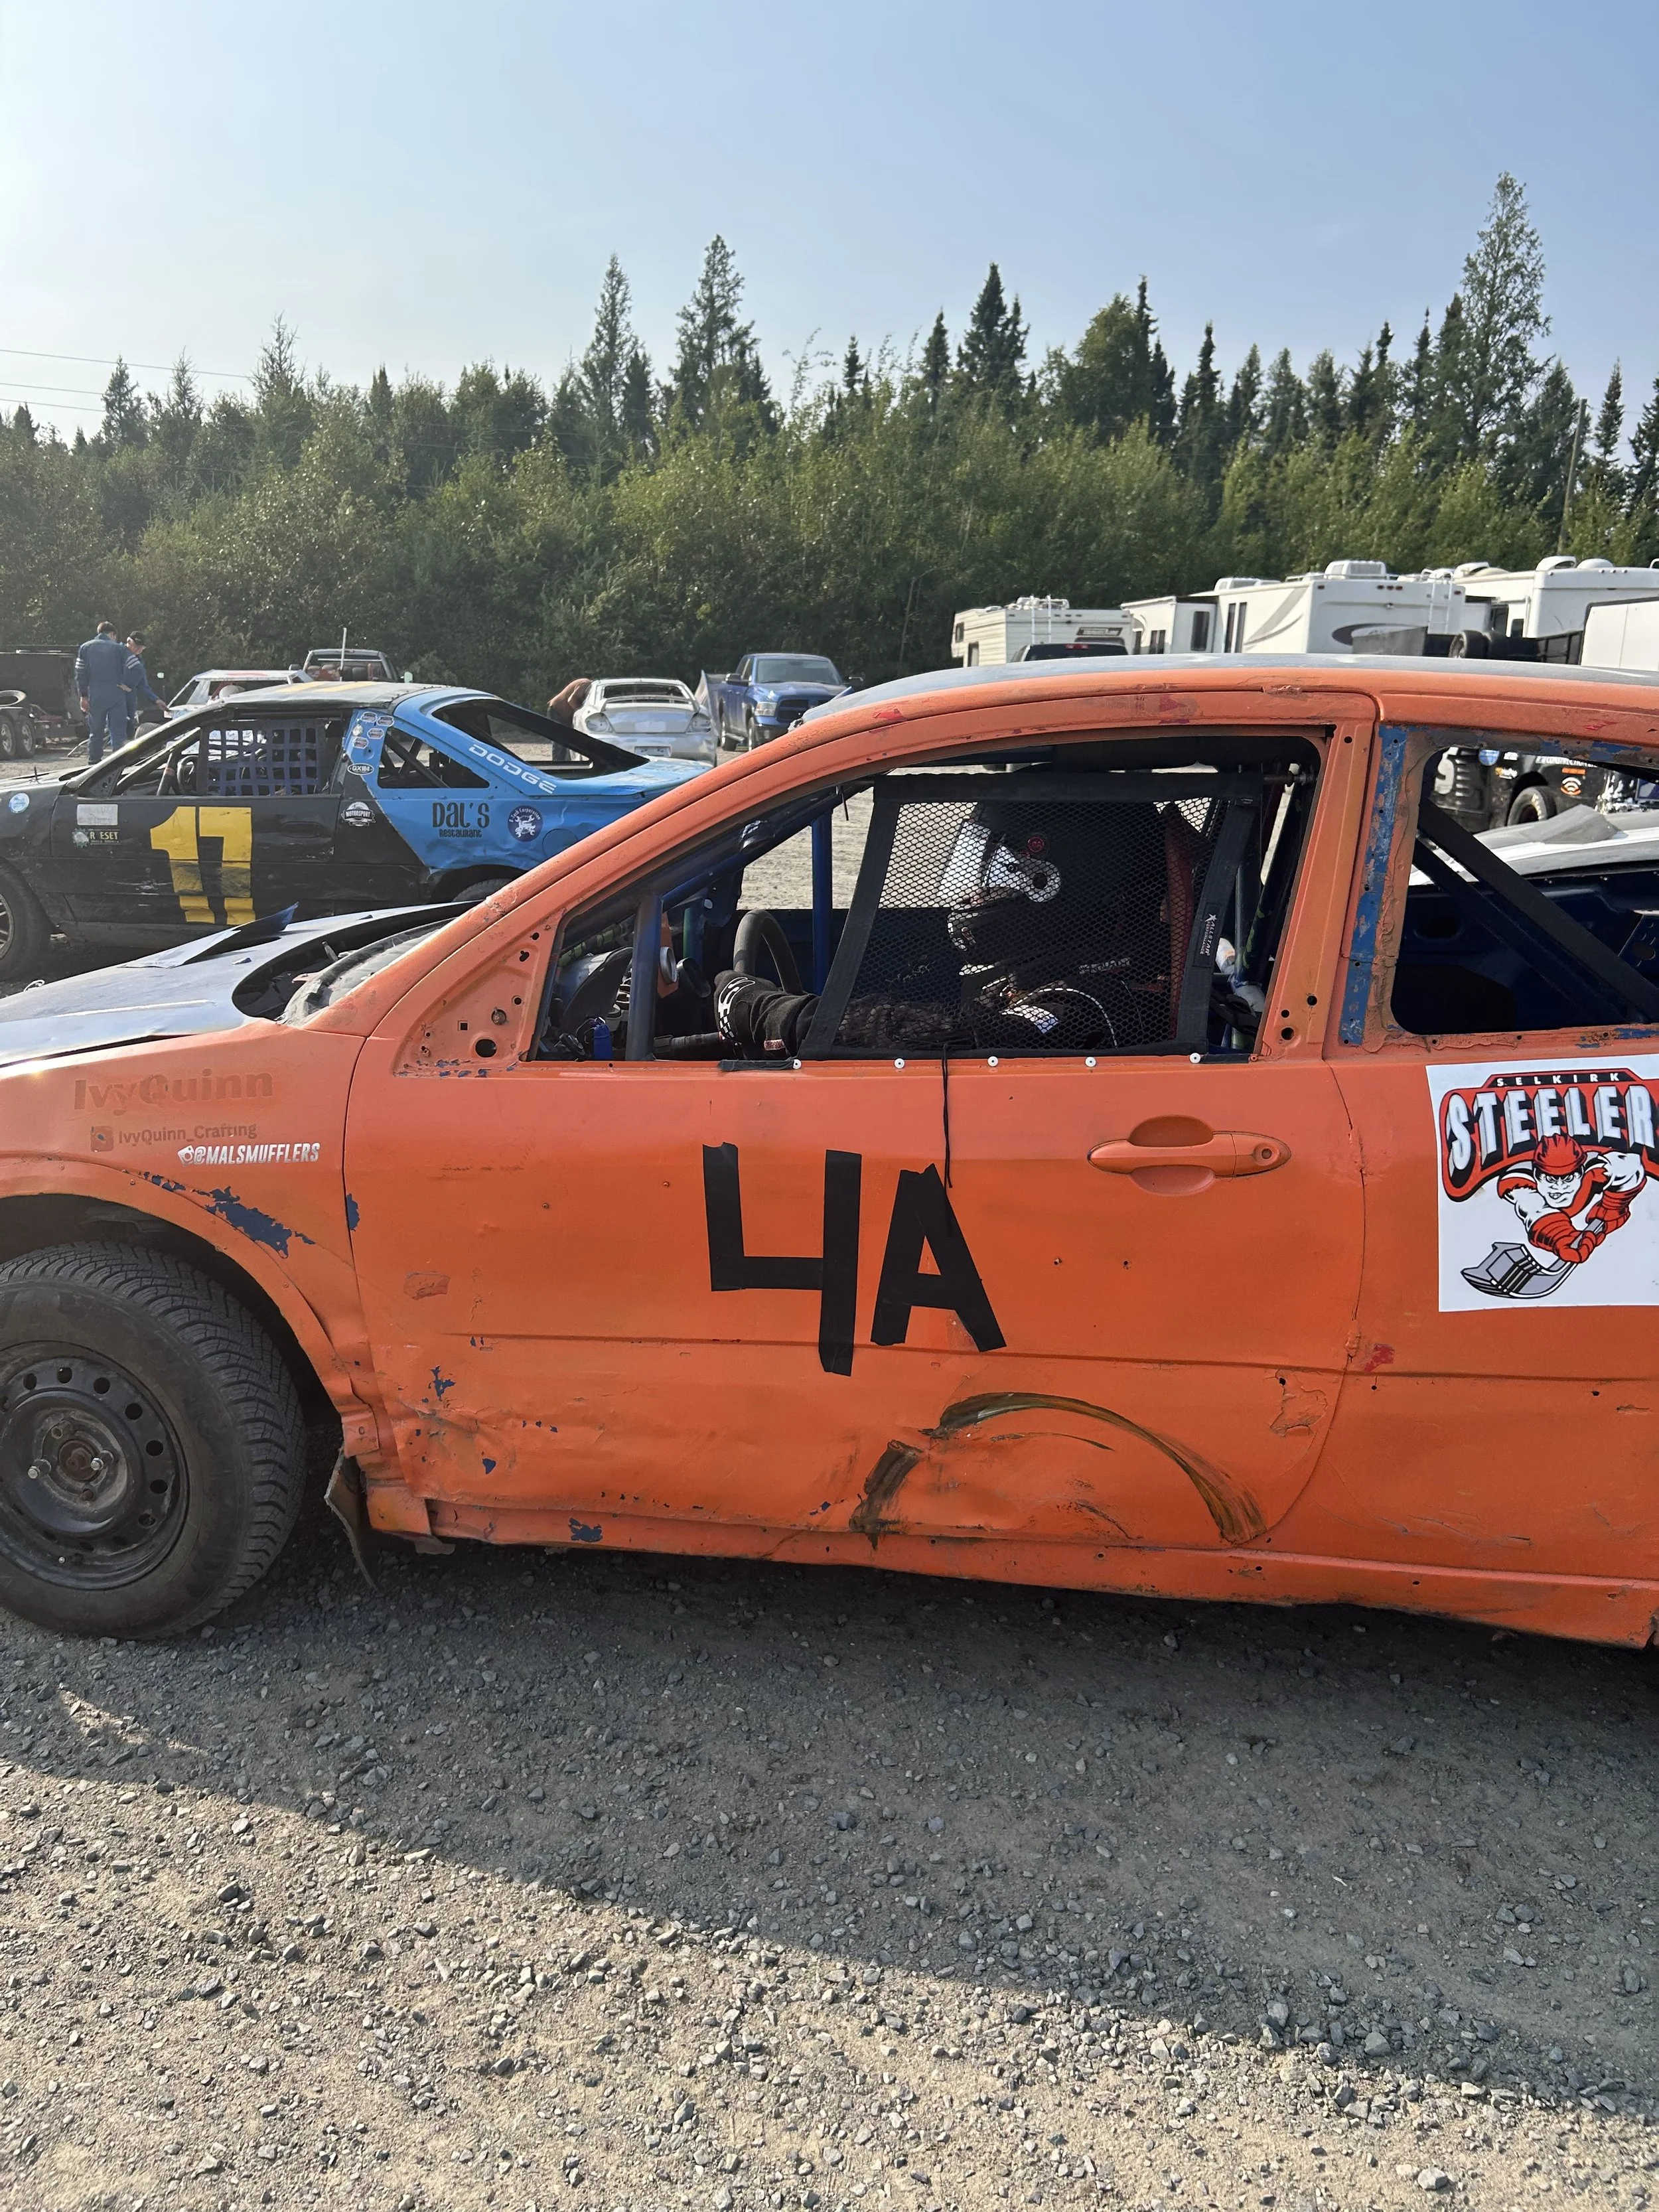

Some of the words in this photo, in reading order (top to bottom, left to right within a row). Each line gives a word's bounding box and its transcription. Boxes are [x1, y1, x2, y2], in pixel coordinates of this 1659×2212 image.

[469, 743, 557, 794] DODGE
[150, 806, 255, 925] 17
[1204, 921, 1216, 954] ALLSTAR
[74, 1069, 273, 1116] IvyQuinn
[1496, 1072, 1621, 1087] SELKIRK
[118, 1124, 257, 1147] IvyQuinn_Crafting
[1447, 1084, 1659, 1183] STEELER
[193, 1143, 321, 1165] @MALSMUFFLERS
